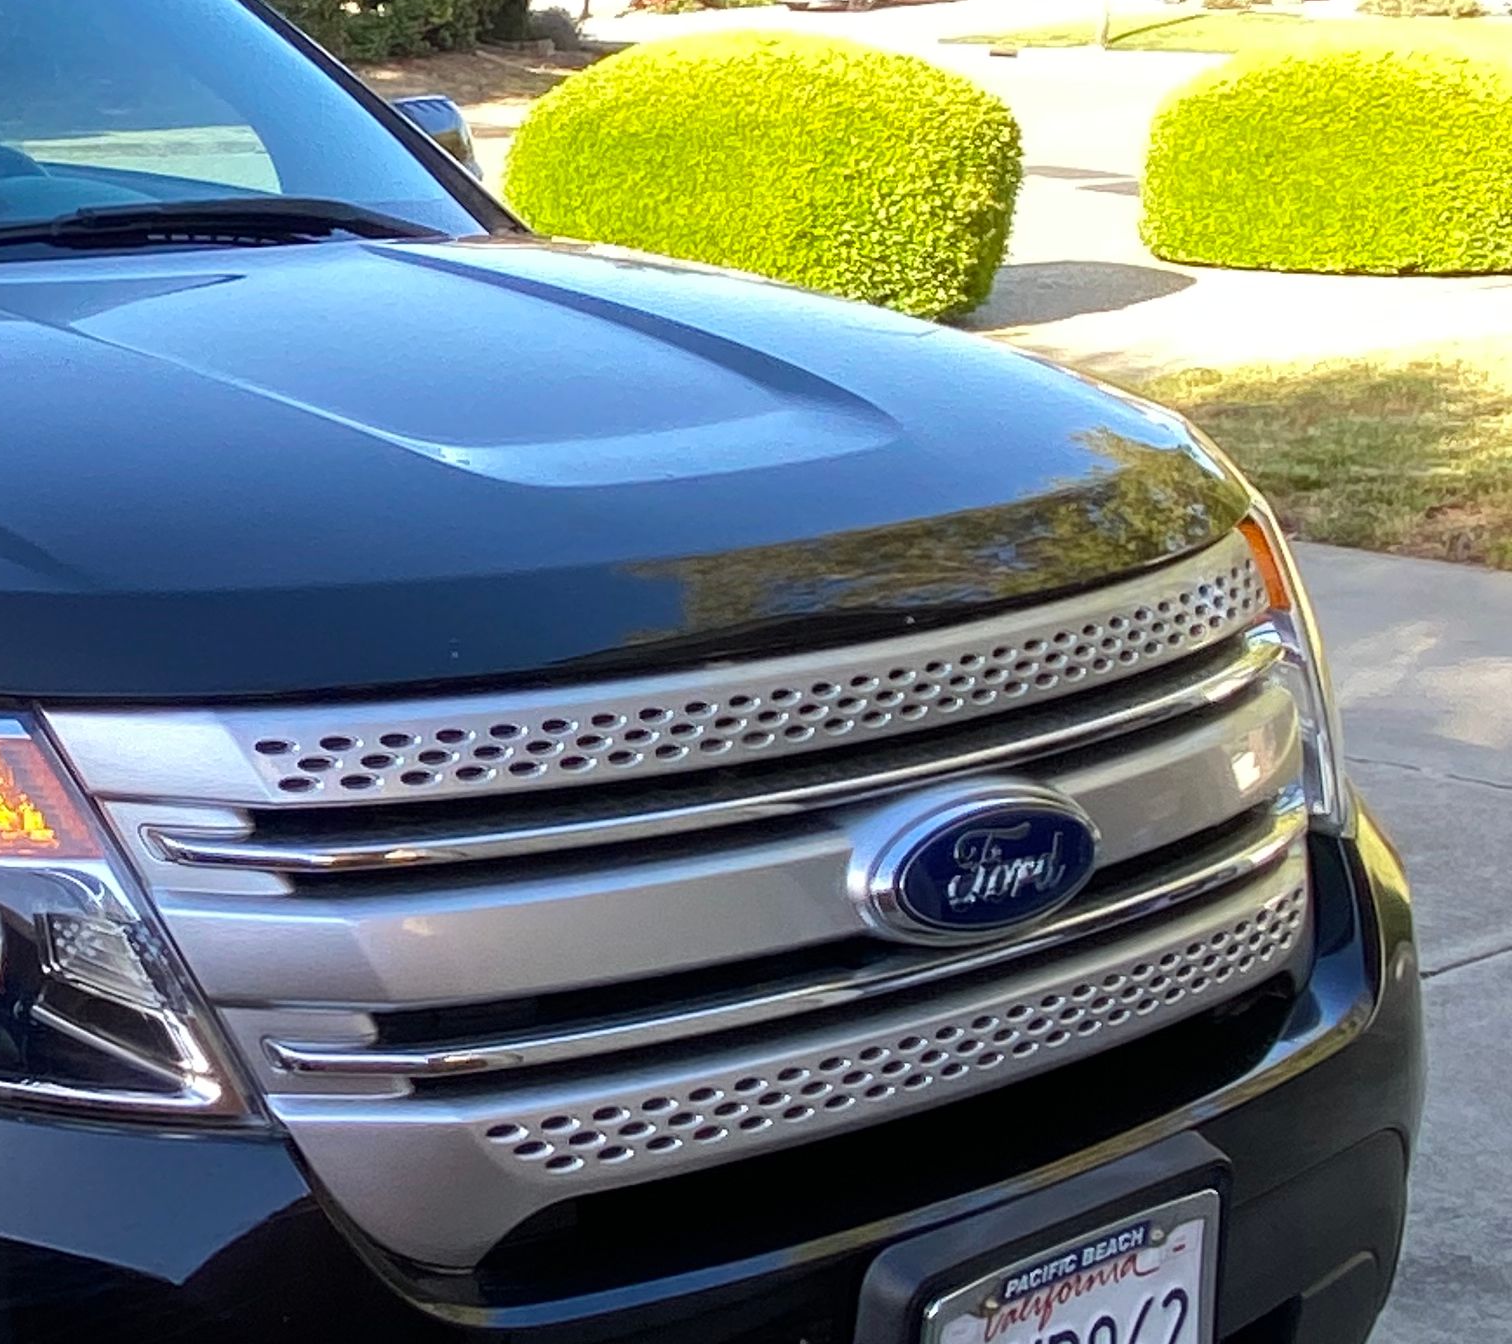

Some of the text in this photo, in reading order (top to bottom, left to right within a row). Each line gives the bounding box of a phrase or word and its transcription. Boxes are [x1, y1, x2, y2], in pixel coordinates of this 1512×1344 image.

[947, 821, 1066, 912] Ford
[1005, 1226, 1146, 1298] PACIFIC BEACH
